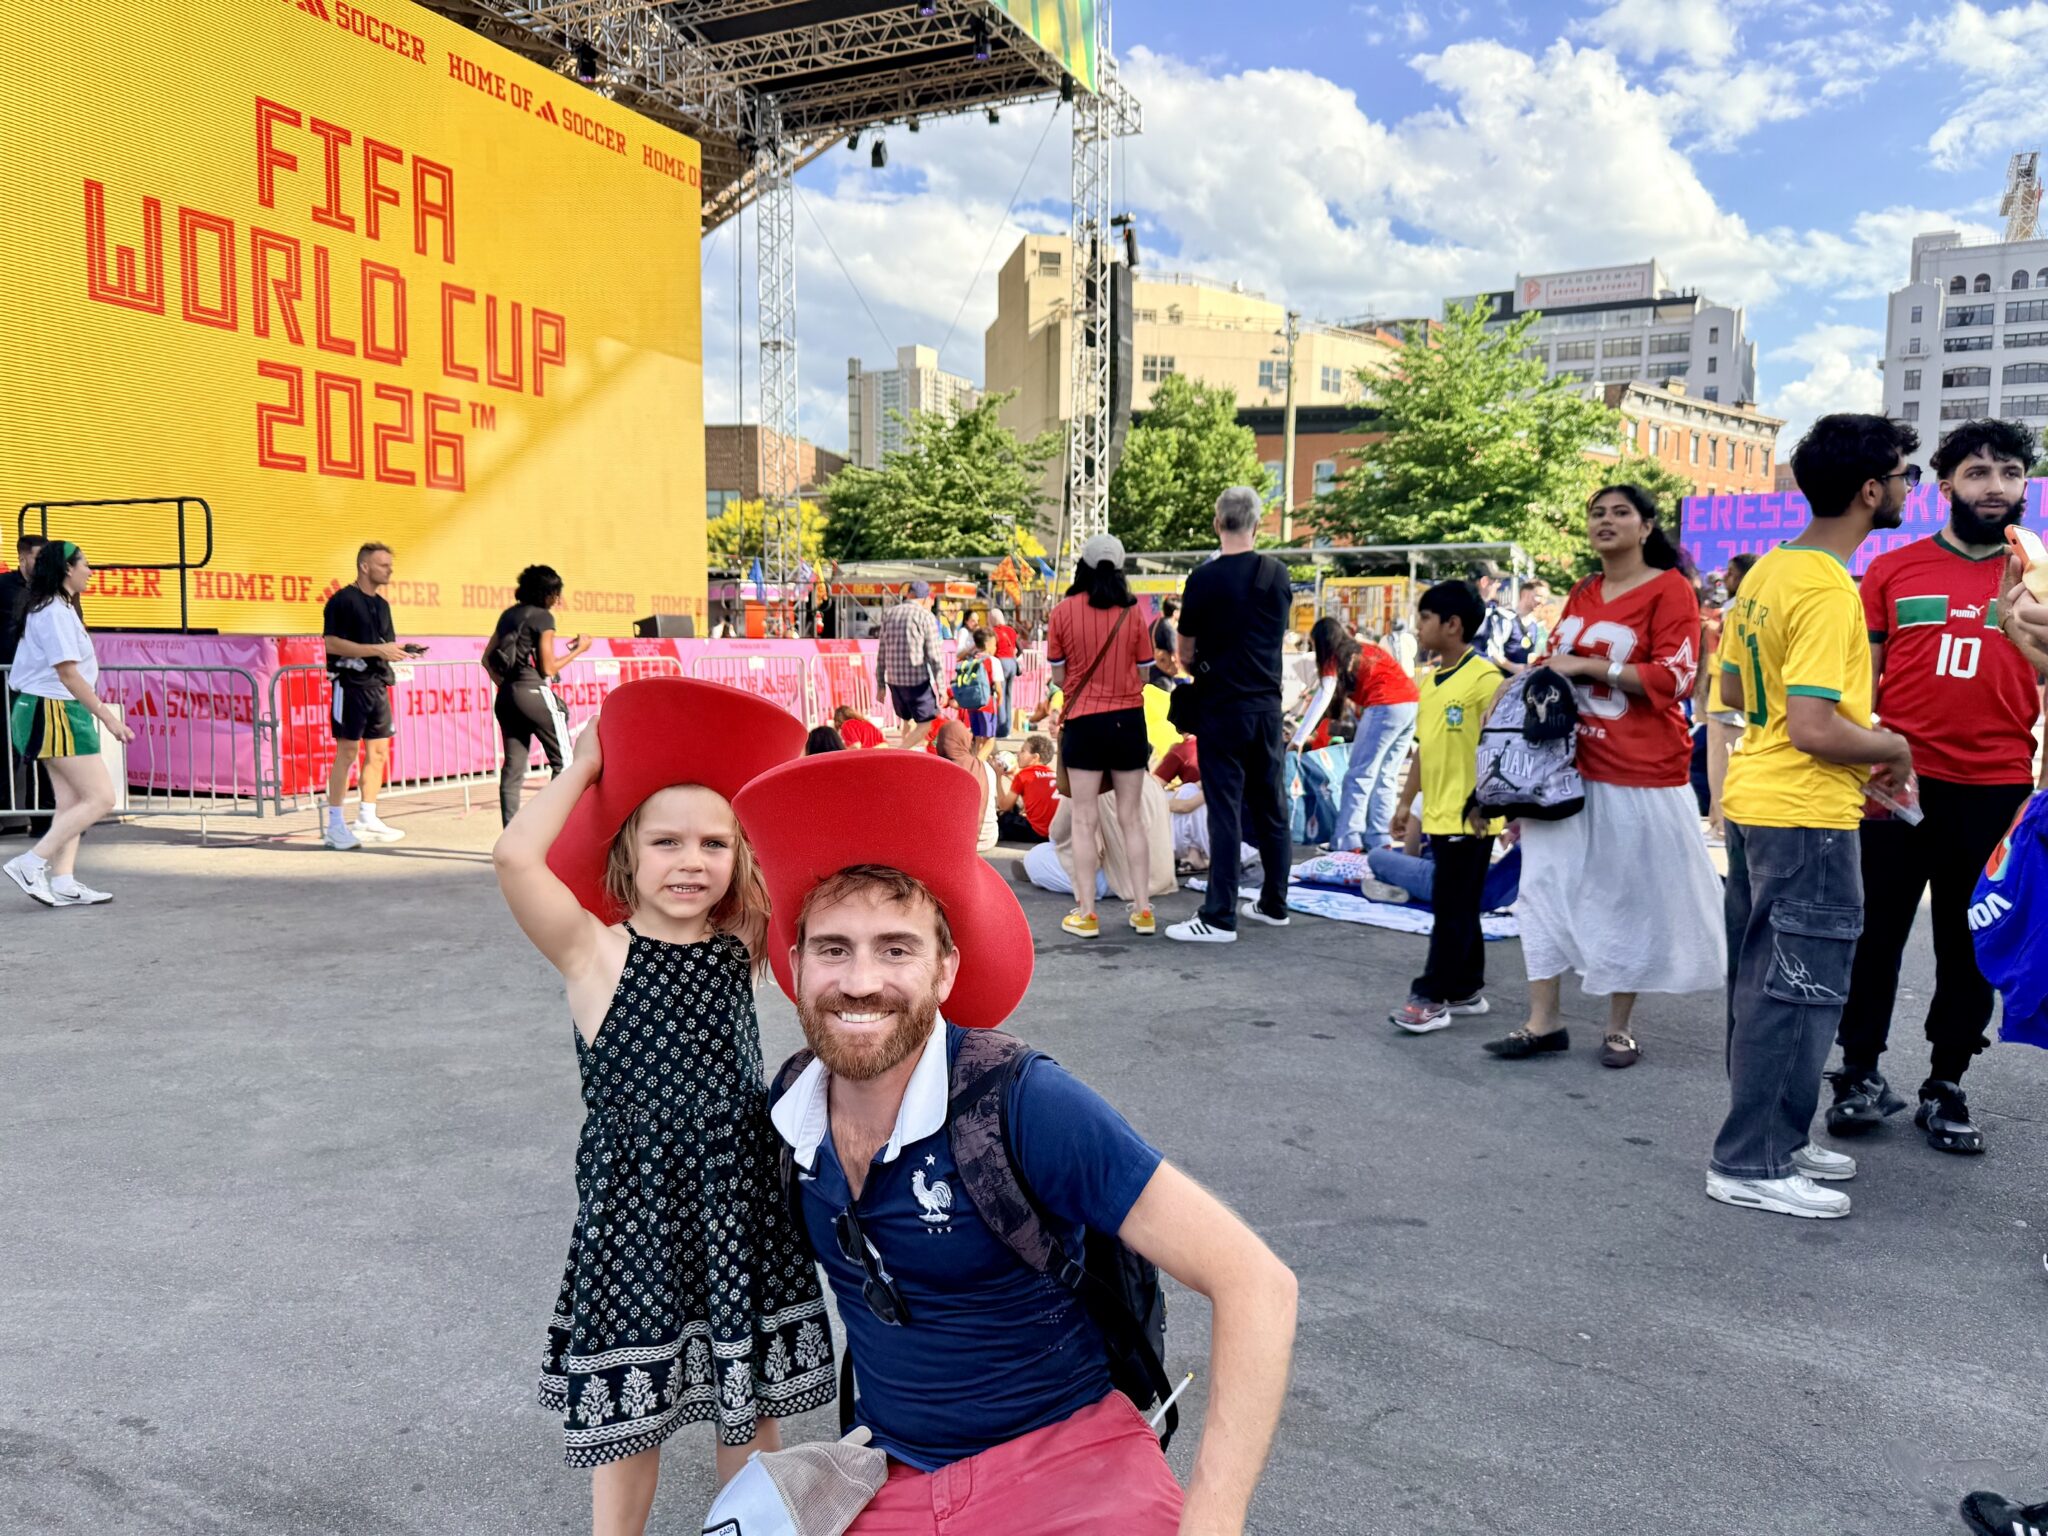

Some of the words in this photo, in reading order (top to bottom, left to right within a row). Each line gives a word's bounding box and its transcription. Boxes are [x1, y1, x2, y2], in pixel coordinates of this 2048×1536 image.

[335, 0, 427, 65] SOCCER
[447, 51, 506, 102] HOME
[511, 82, 534, 113] OF
[562, 107, 627, 156] SOCCER
[642, 144, 686, 182] HOME
[255, 95, 455, 264] FIFA
[83, 178, 408, 366] WORLD
[441, 281, 566, 397] CUP
[194, 570, 275, 602] HOME
[282, 575, 313, 603] OF
[573, 591, 635, 614] SOCCER
[1950, 608, 1976, 619] PUMA
[1936, 633, 1982, 679] 10
[407, 687, 472, 716] HOME
[719, 1525, 735, 1536] CASH
